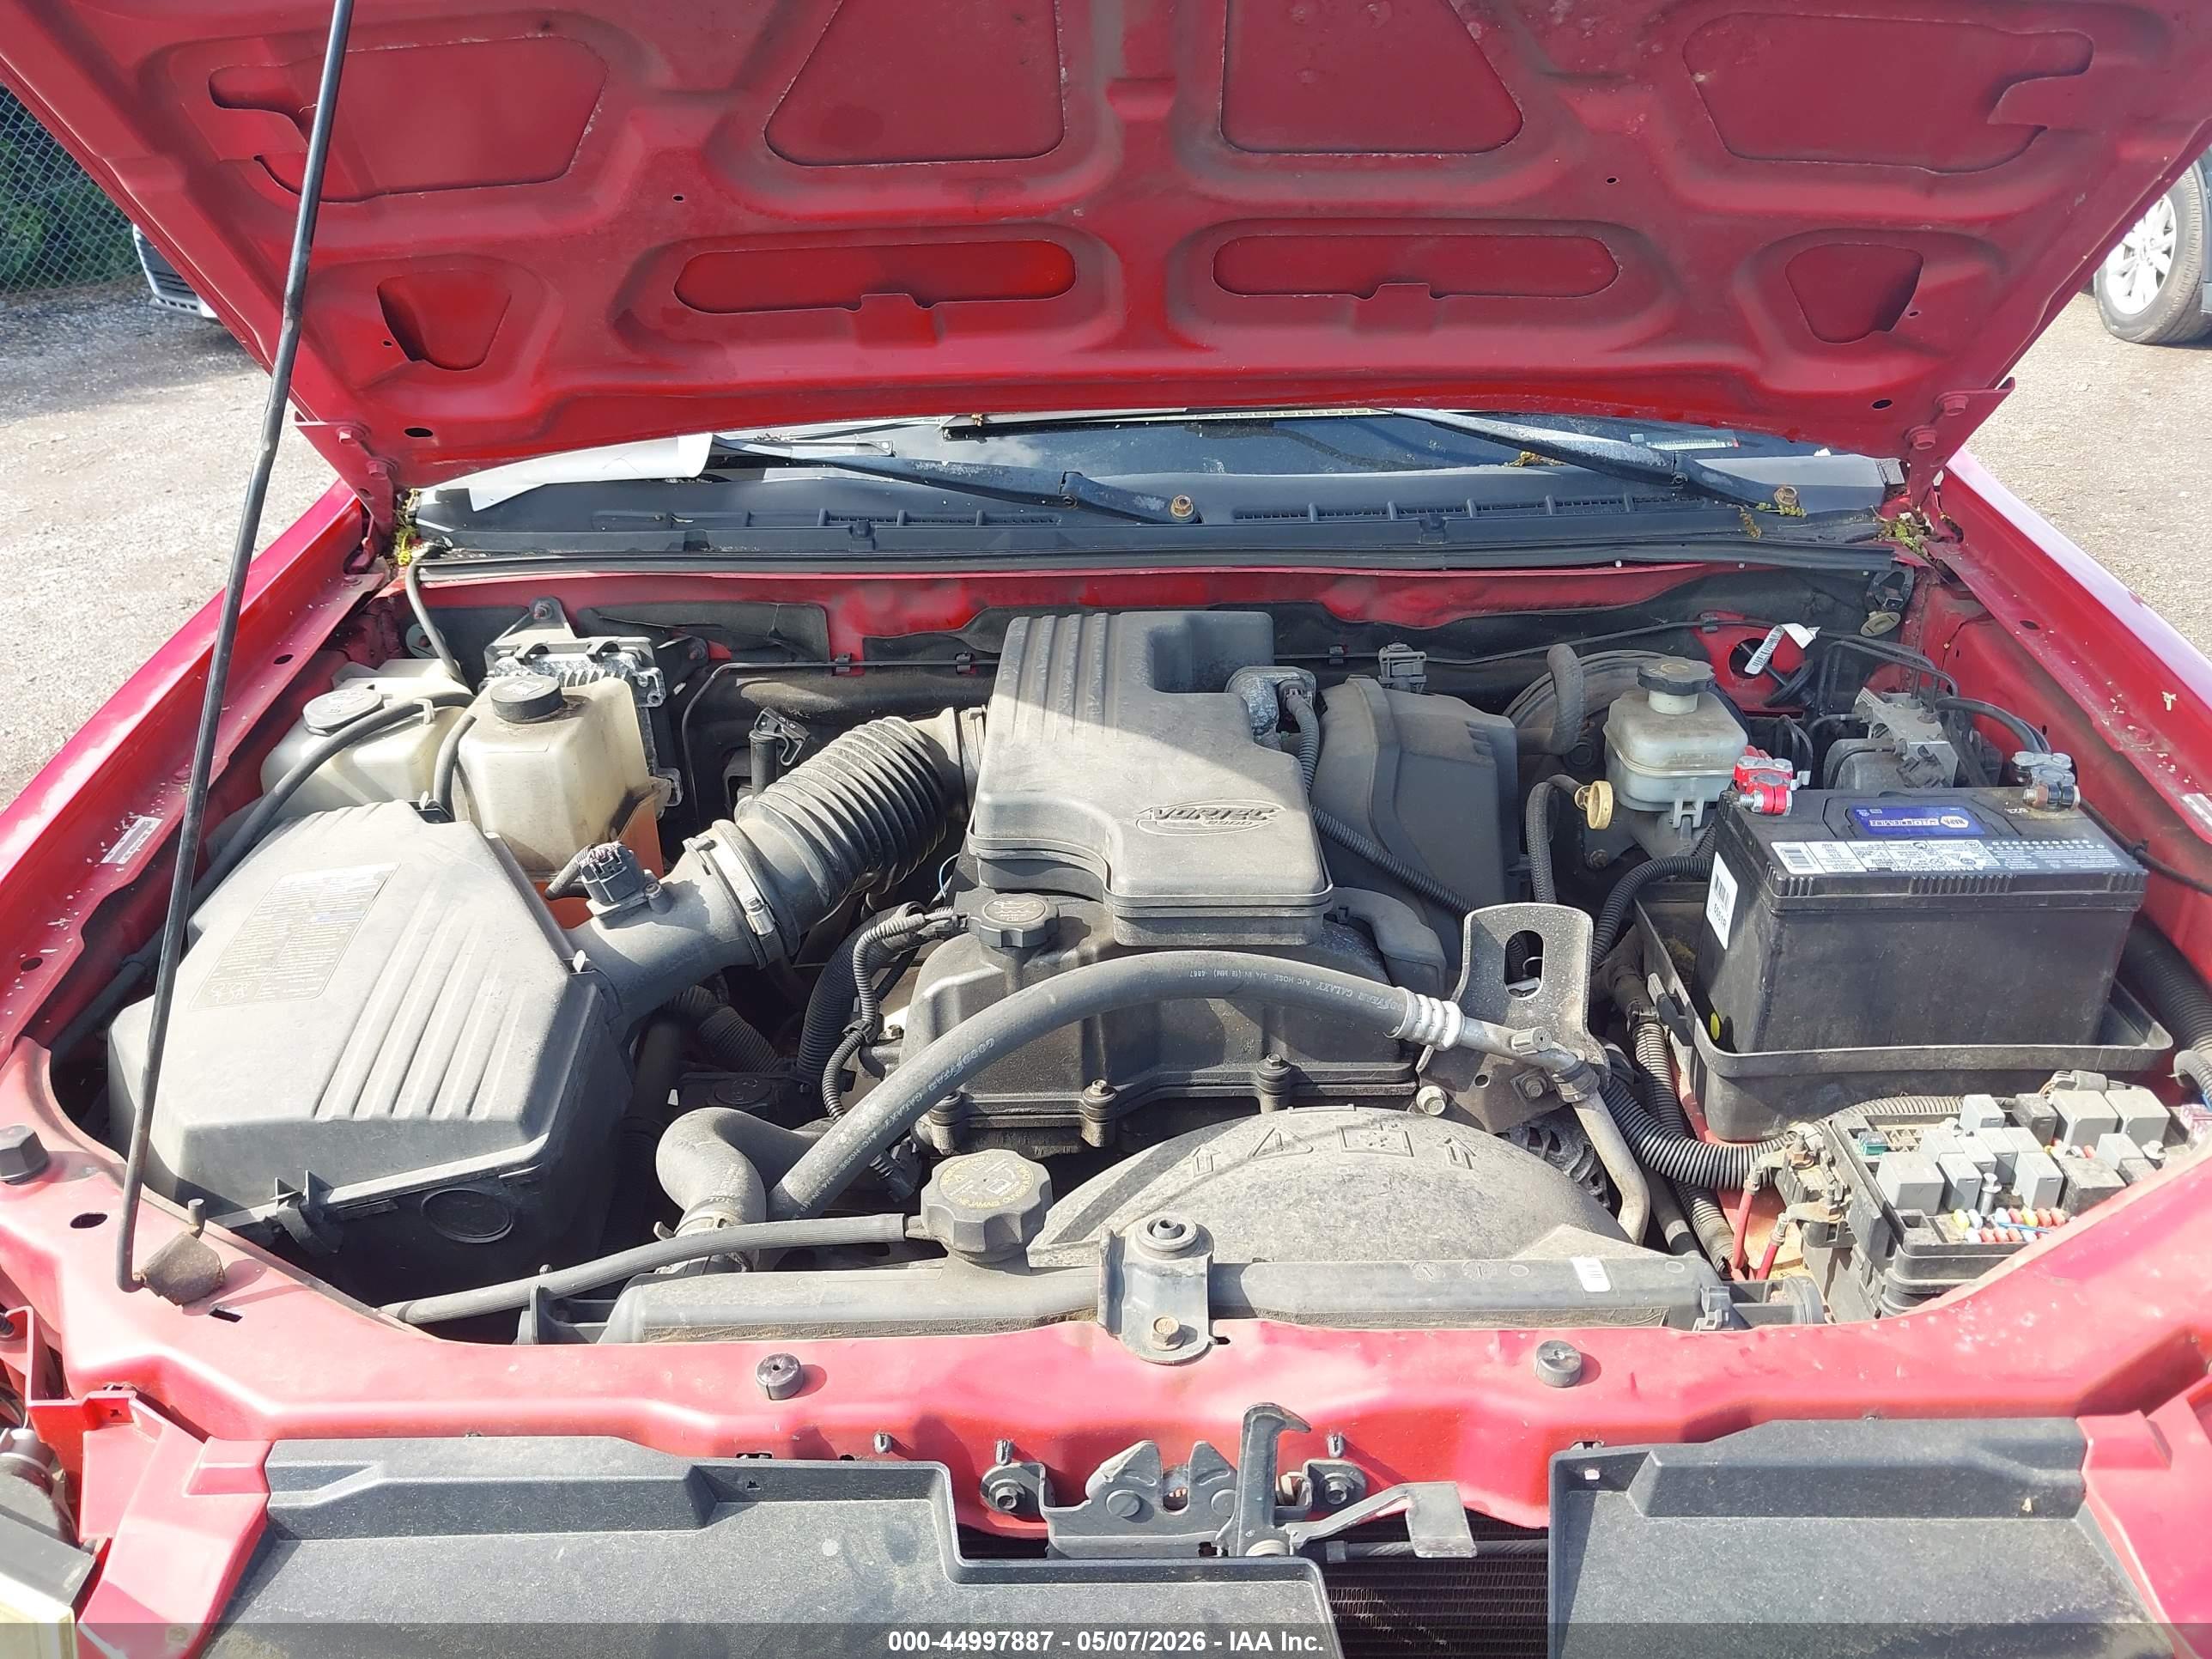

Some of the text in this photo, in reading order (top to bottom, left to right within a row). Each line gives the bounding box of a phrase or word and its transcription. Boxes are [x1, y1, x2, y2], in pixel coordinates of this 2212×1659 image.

[1152, 806, 1276, 821] VORTEC
[1273, 974, 1294, 983] HOSE
[1297, 977, 1311, 986] A/C
[1316, 982, 1353, 998] GALAXY
[927, 1037, 995, 1091] GOODYEAR
[884, 1092, 922, 1130] GALAXY
[837, 1148, 862, 1171] HOSE
